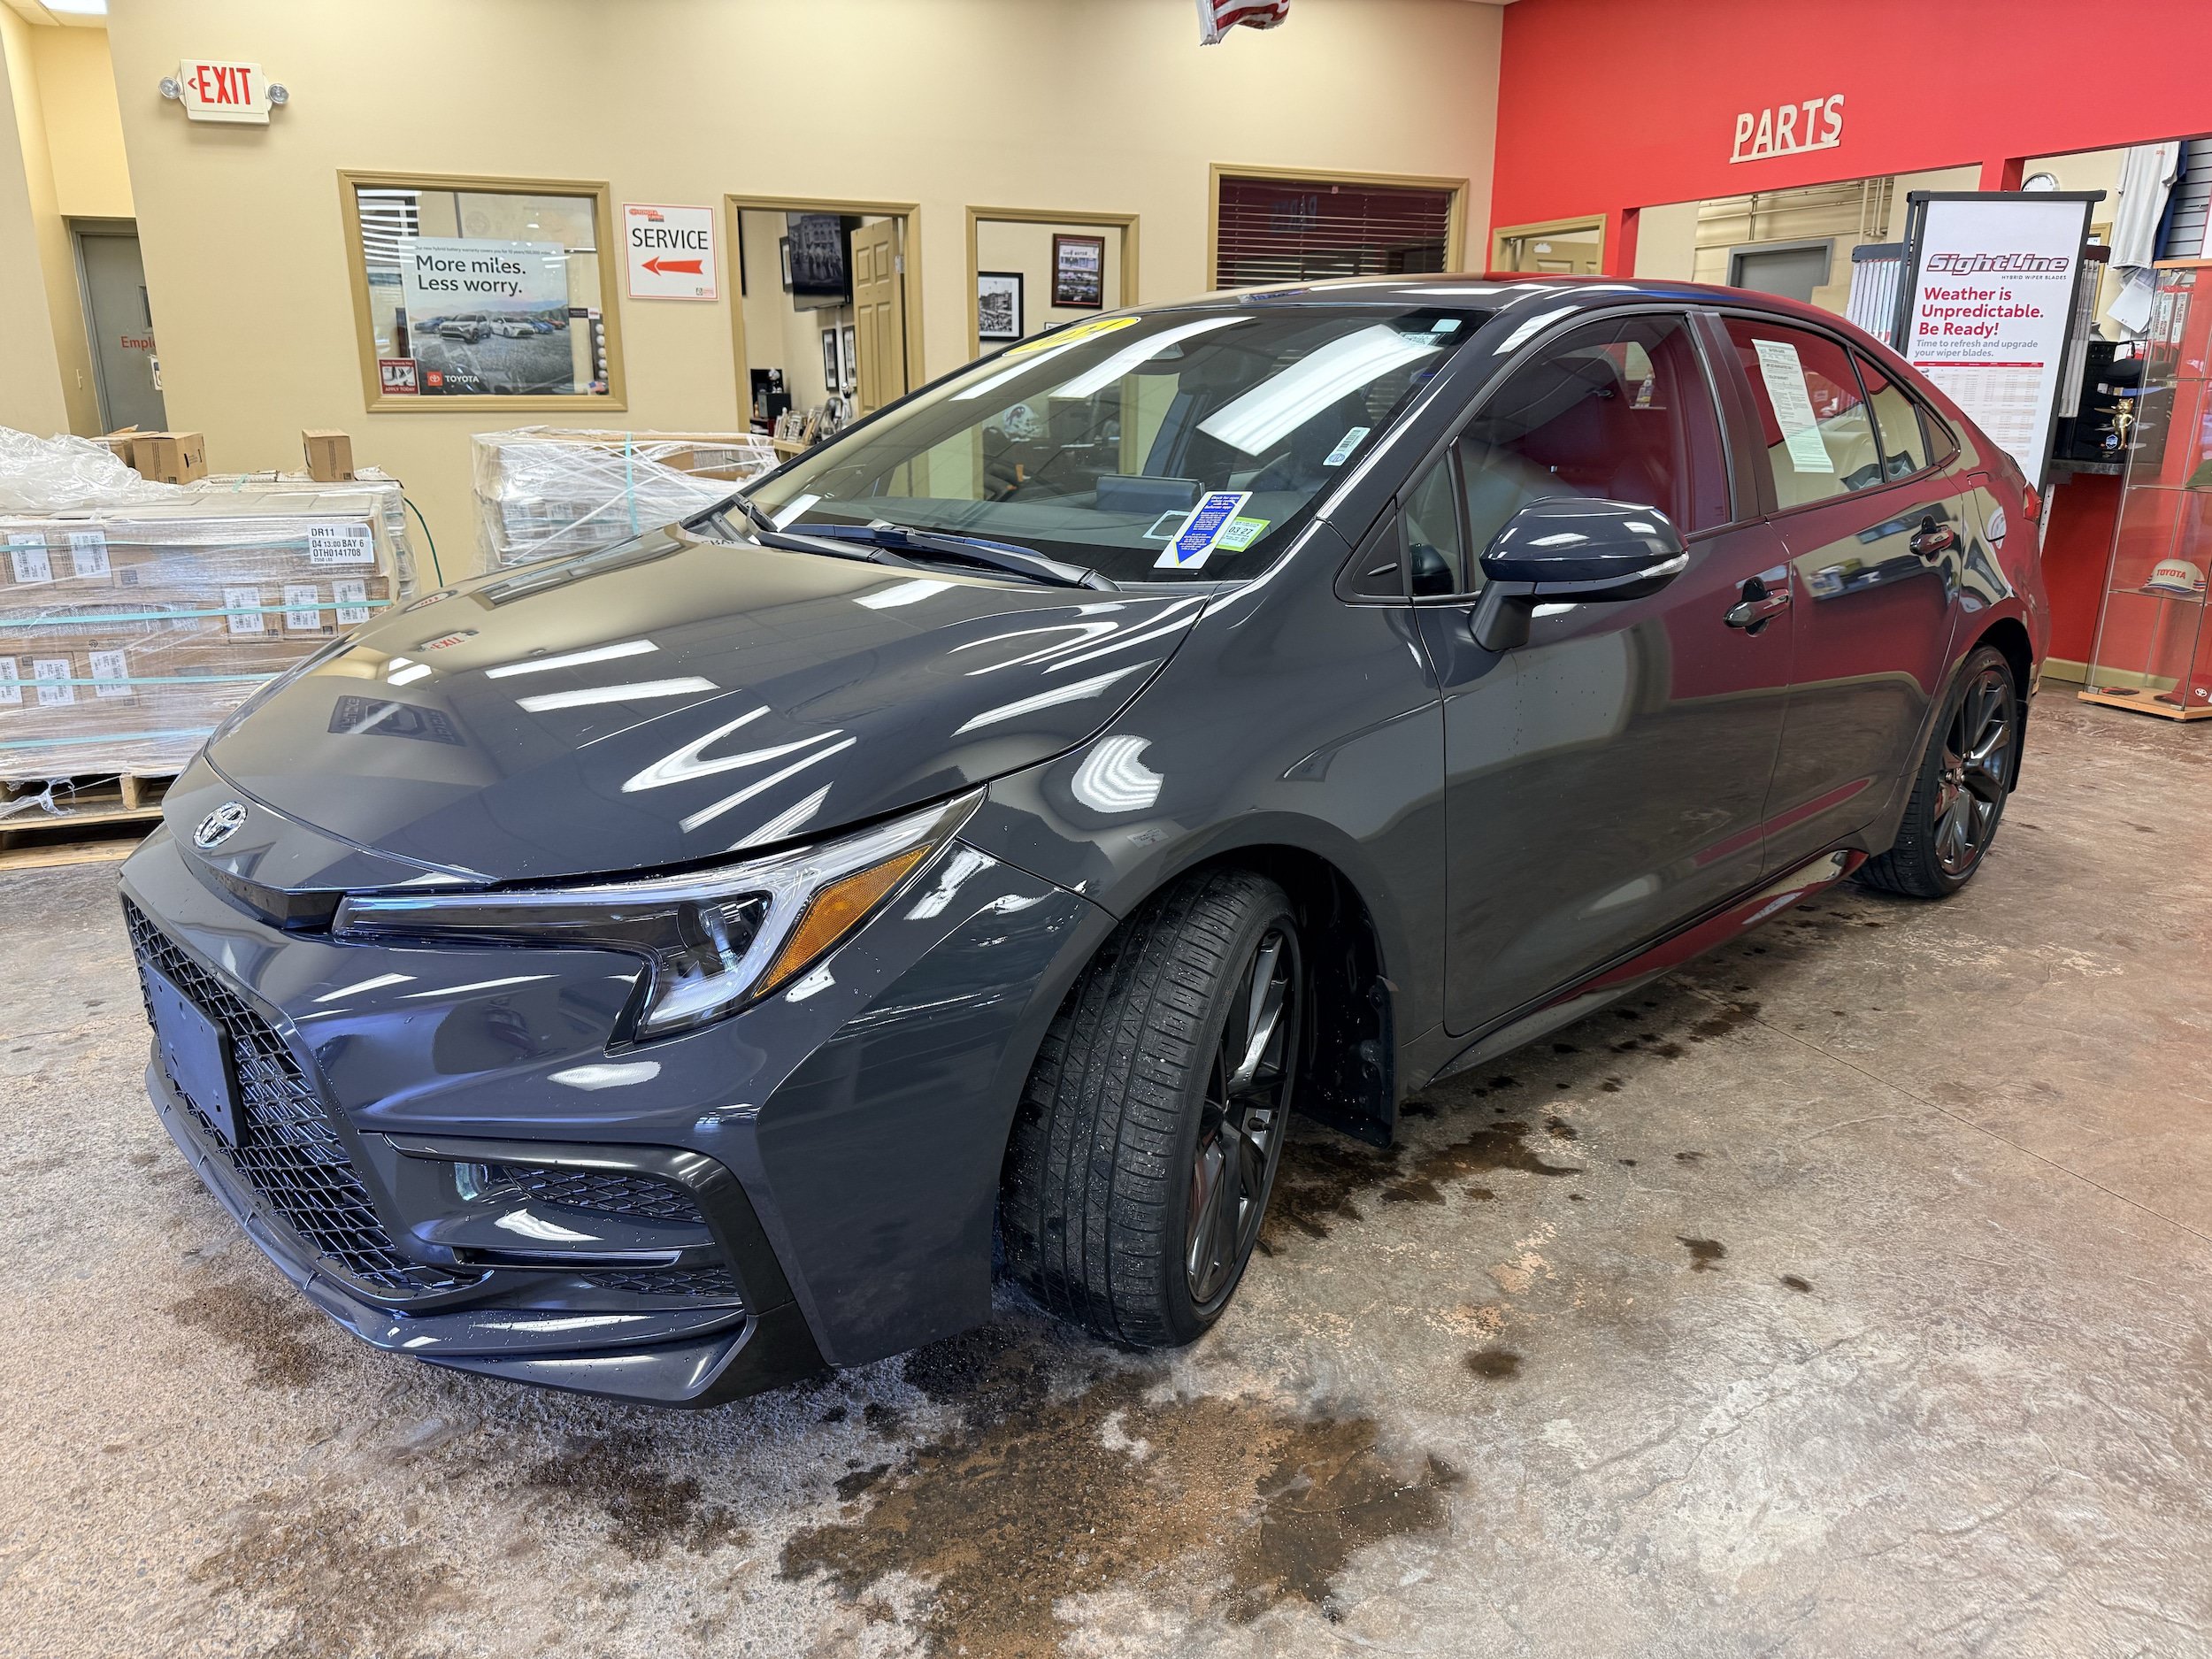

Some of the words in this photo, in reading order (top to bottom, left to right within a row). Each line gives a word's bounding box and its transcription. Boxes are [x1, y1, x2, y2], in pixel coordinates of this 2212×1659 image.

[196, 65, 251, 105] EXIT
[1732, 93, 1845, 162] PARTS
[632, 227, 709, 250] SERVICE
[416, 255, 466, 273] More
[472, 257, 526, 274] miles.
[1926, 254, 2069, 275] SightLine
[419, 274, 458, 291] Less
[464, 280, 523, 297] worry.
[1924, 287, 1996, 301] Weather
[1999, 287, 2012, 301] is
[1922, 304, 2044, 320] Unpredictable.
[1919, 322, 1939, 335] Be
[1944, 322, 2000, 339] Ready!
[1916, 339, 1938, 348] Time
[2001, 340, 2039, 349] upgrade
[1937, 349, 1961, 358] wiper
[1962, 349, 1994, 357] blades.
[311, 527, 334, 536] DR11
[2156, 569, 2186, 580] TOYOTA
